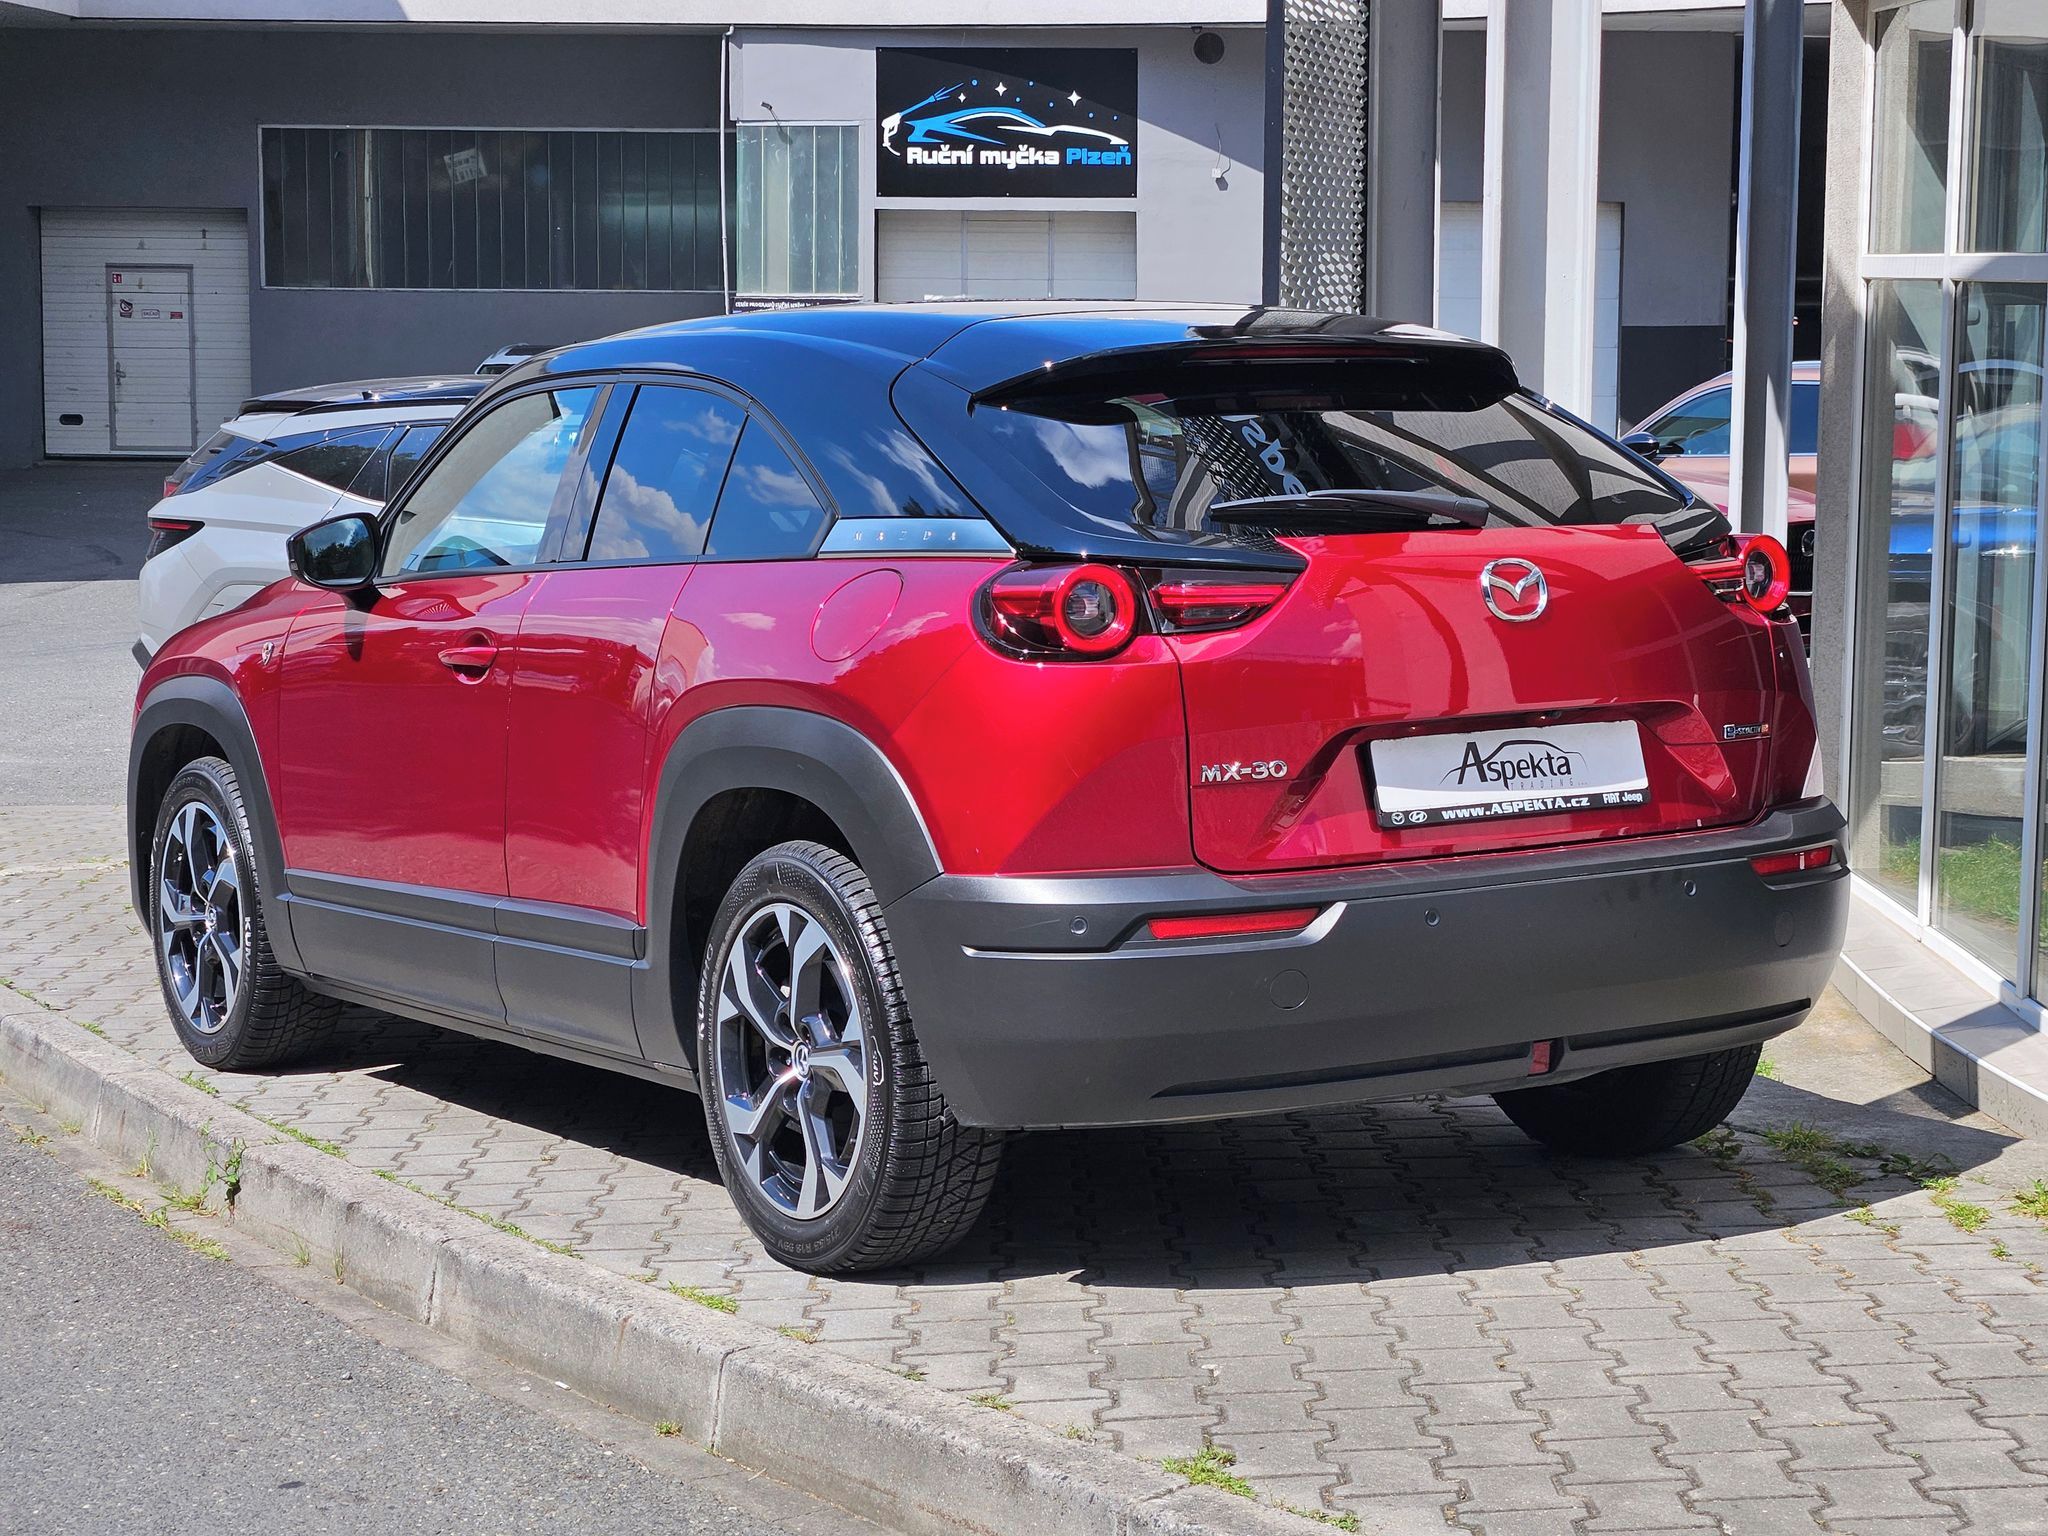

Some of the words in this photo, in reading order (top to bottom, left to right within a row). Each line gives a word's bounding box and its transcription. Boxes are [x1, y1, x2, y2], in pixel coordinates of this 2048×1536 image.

[906, 144, 973, 165] Ruční
[980, 145, 1060, 170] myčka
[1066, 145, 1132, 166] Plzeň
[1201, 760, 1288, 783] MX-30
[1457, 741, 1572, 791] Aspekta
[1510, 777, 1574, 791] TRADING
[1441, 796, 1591, 820] www.ASPEKTA.cz
[1602, 792, 1620, 804] FIAT
[1622, 791, 1643, 803] Jeep
[699, 943, 714, 1041] KUMHO
